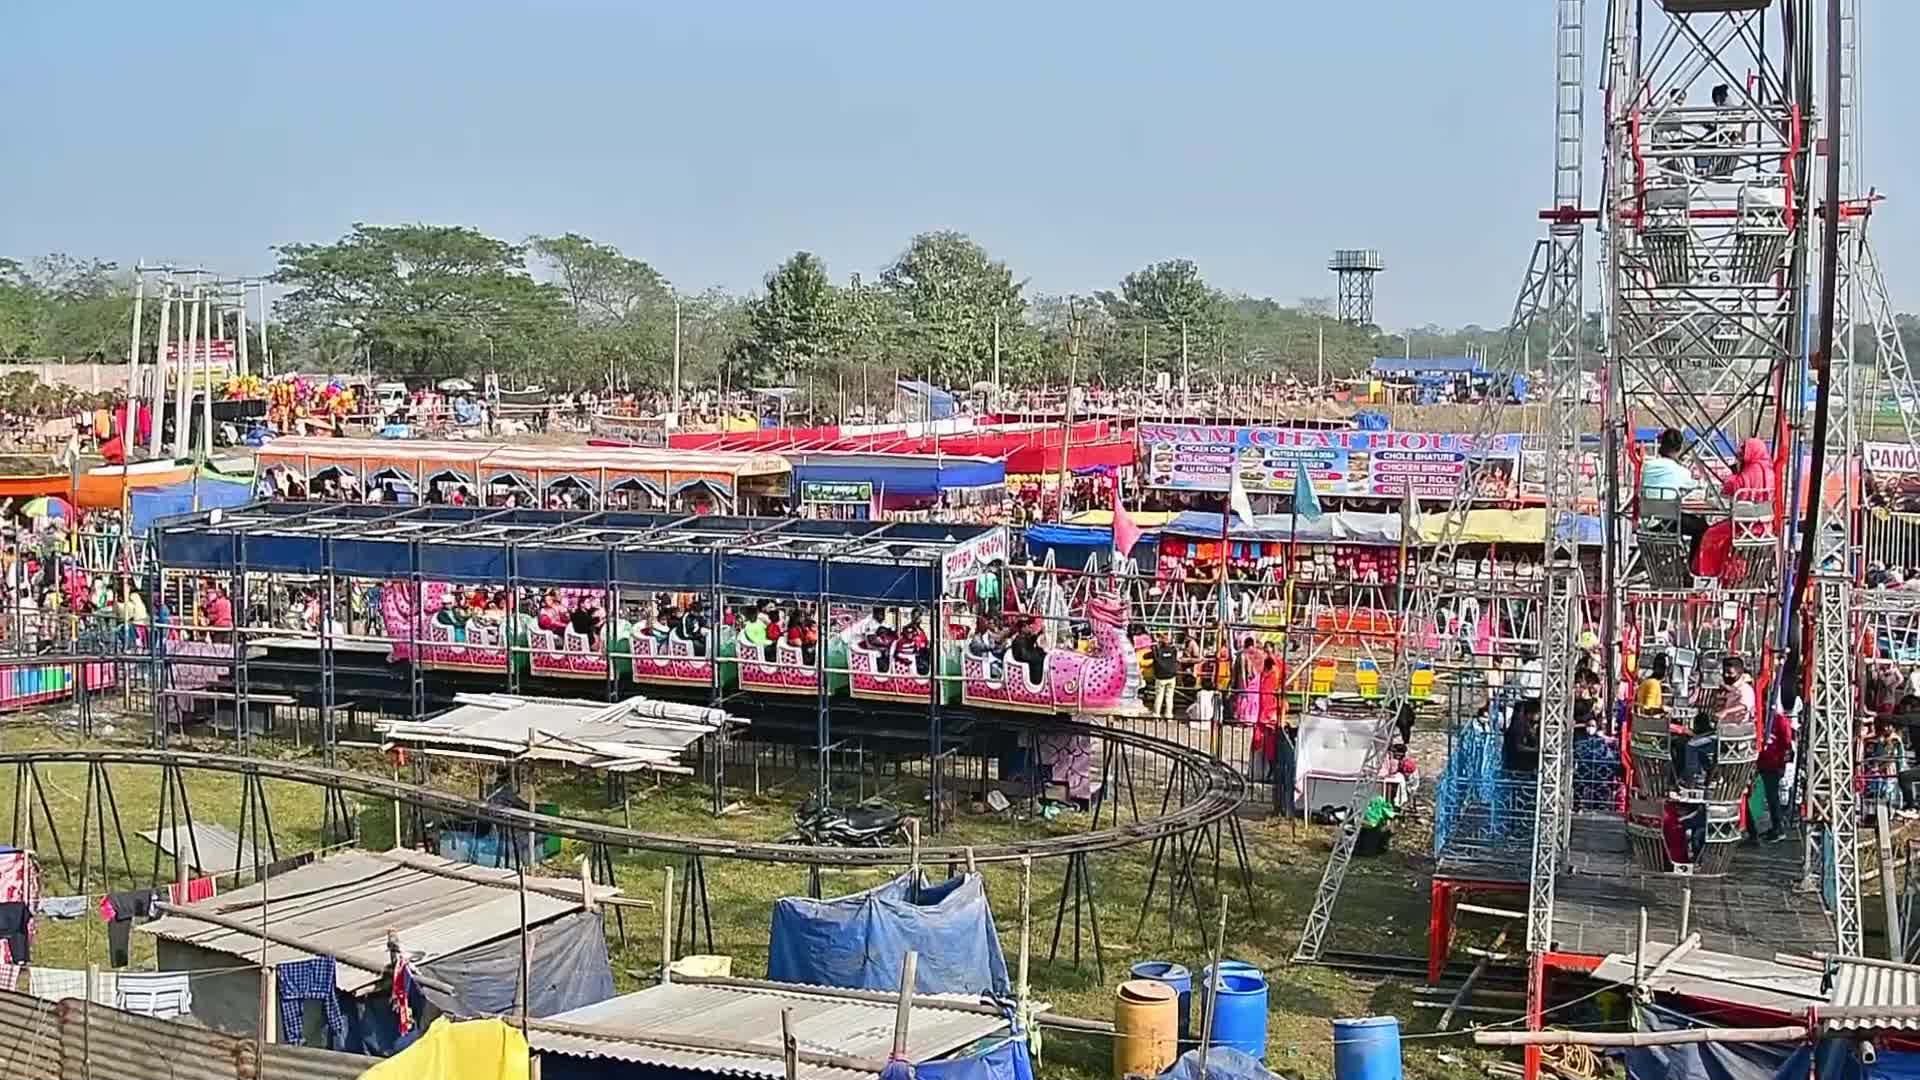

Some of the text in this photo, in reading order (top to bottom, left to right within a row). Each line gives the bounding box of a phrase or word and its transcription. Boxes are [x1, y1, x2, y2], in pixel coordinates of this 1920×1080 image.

[1709, 271, 1720, 282] 6
[1249, 431, 1349, 447] CHAT
[1369, 433, 1508, 450] HOUSE
[1383, 452, 1455, 461] CHOLE BHATURE
[1381, 463, 1420, 471] CHICKEN
[1428, 476, 1455, 484] ROLL
[1700, 578, 1711, 588] 7
